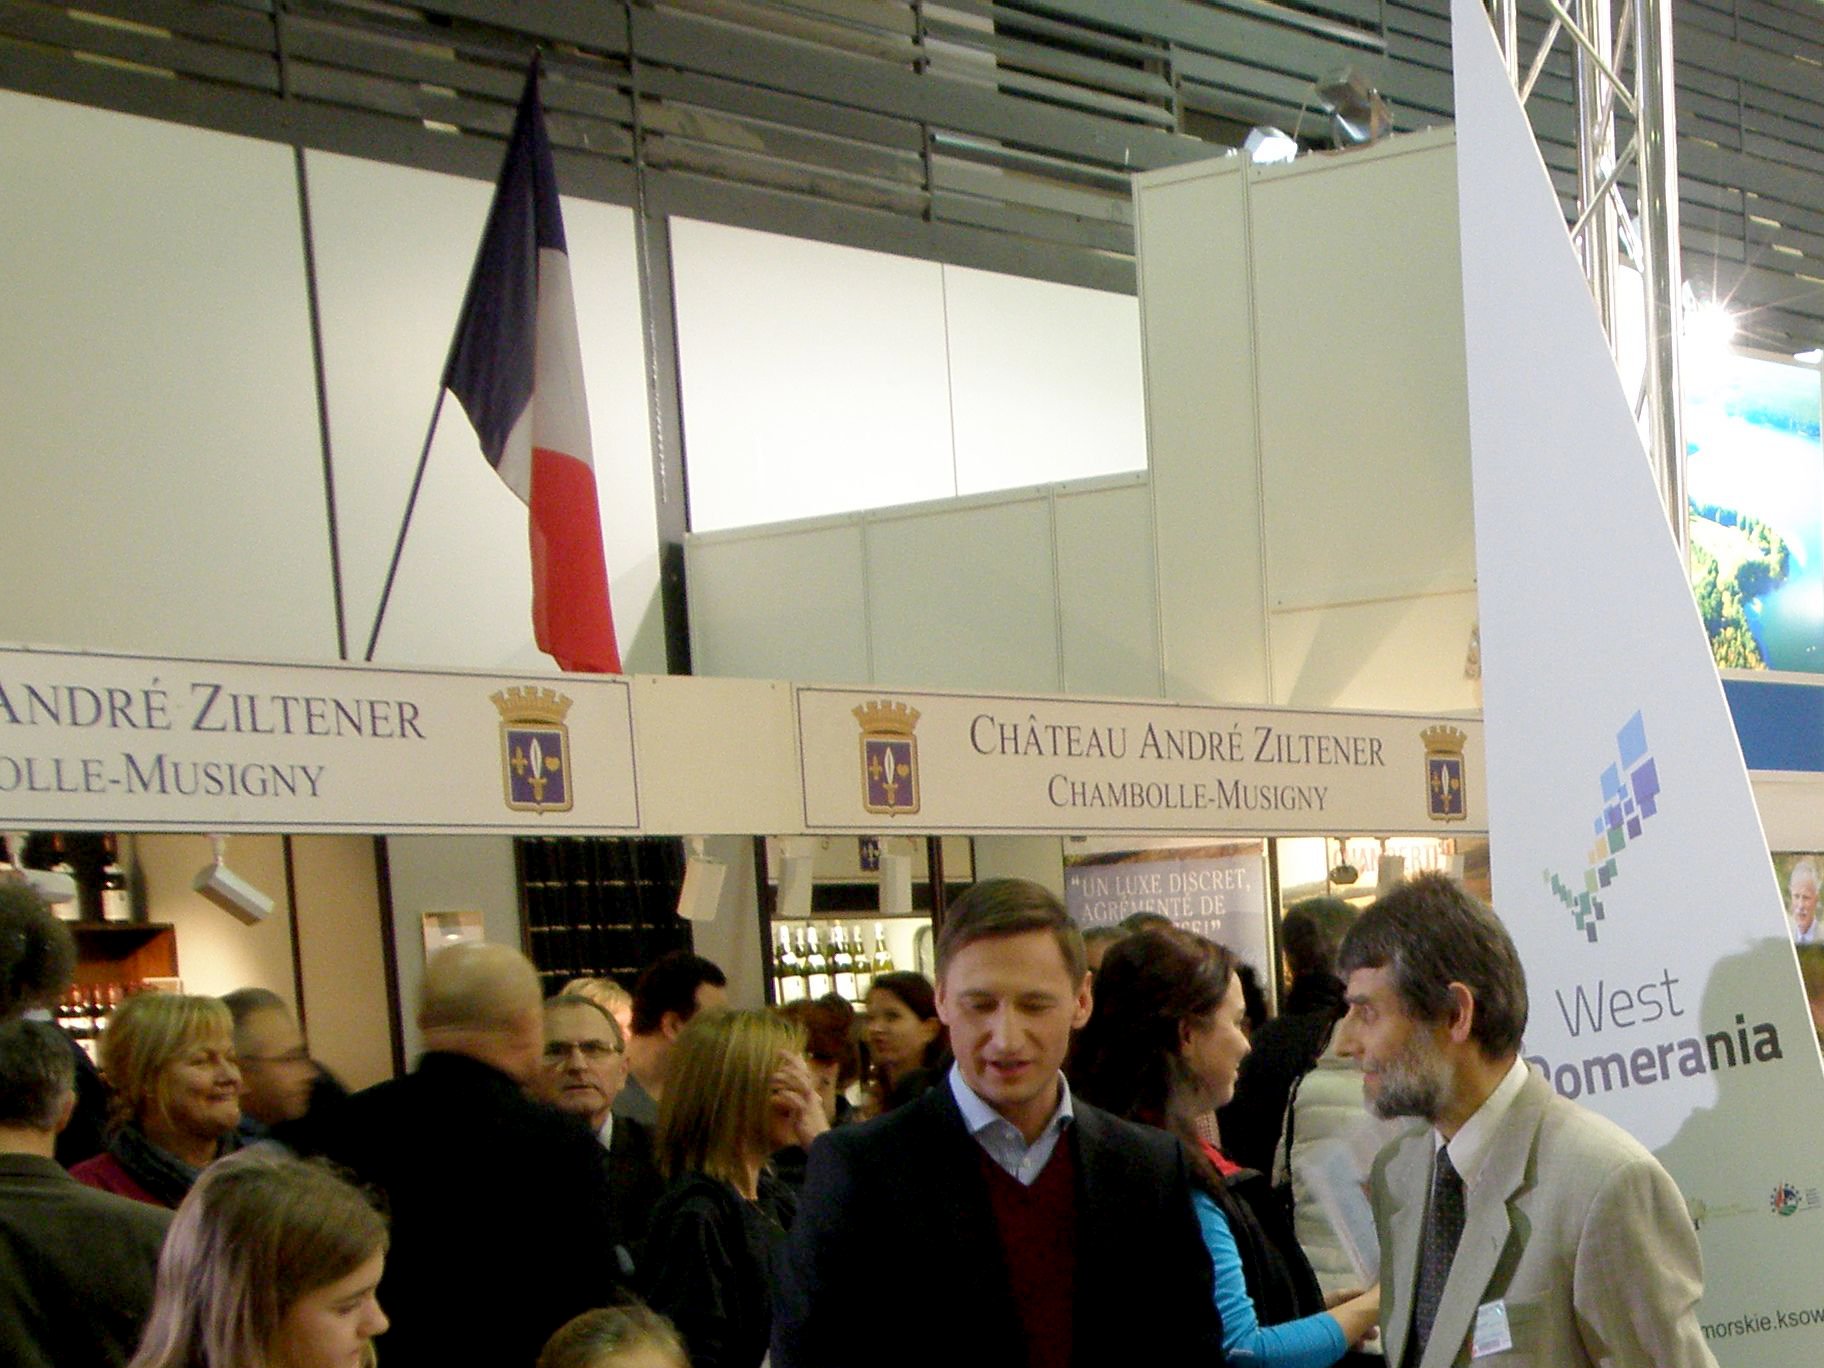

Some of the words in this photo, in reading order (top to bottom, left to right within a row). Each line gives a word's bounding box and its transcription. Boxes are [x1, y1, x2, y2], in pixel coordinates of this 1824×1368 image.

[190, 682, 427, 740] ZILTENER
[969, 713, 1128, 759] CHÂTEAU
[1140, 722, 1245, 763] ANDRÉ
[1254, 725, 1386, 767] ZILTENER
[1048, 773, 1329, 812] CHAMBOLLE-MUSIGNY
[1116, 873, 1162, 897] LUXE
[1169, 868, 1252, 894] DISCRET,
[1200, 894, 1227, 916] DE
[1555, 968, 1685, 1038] West
